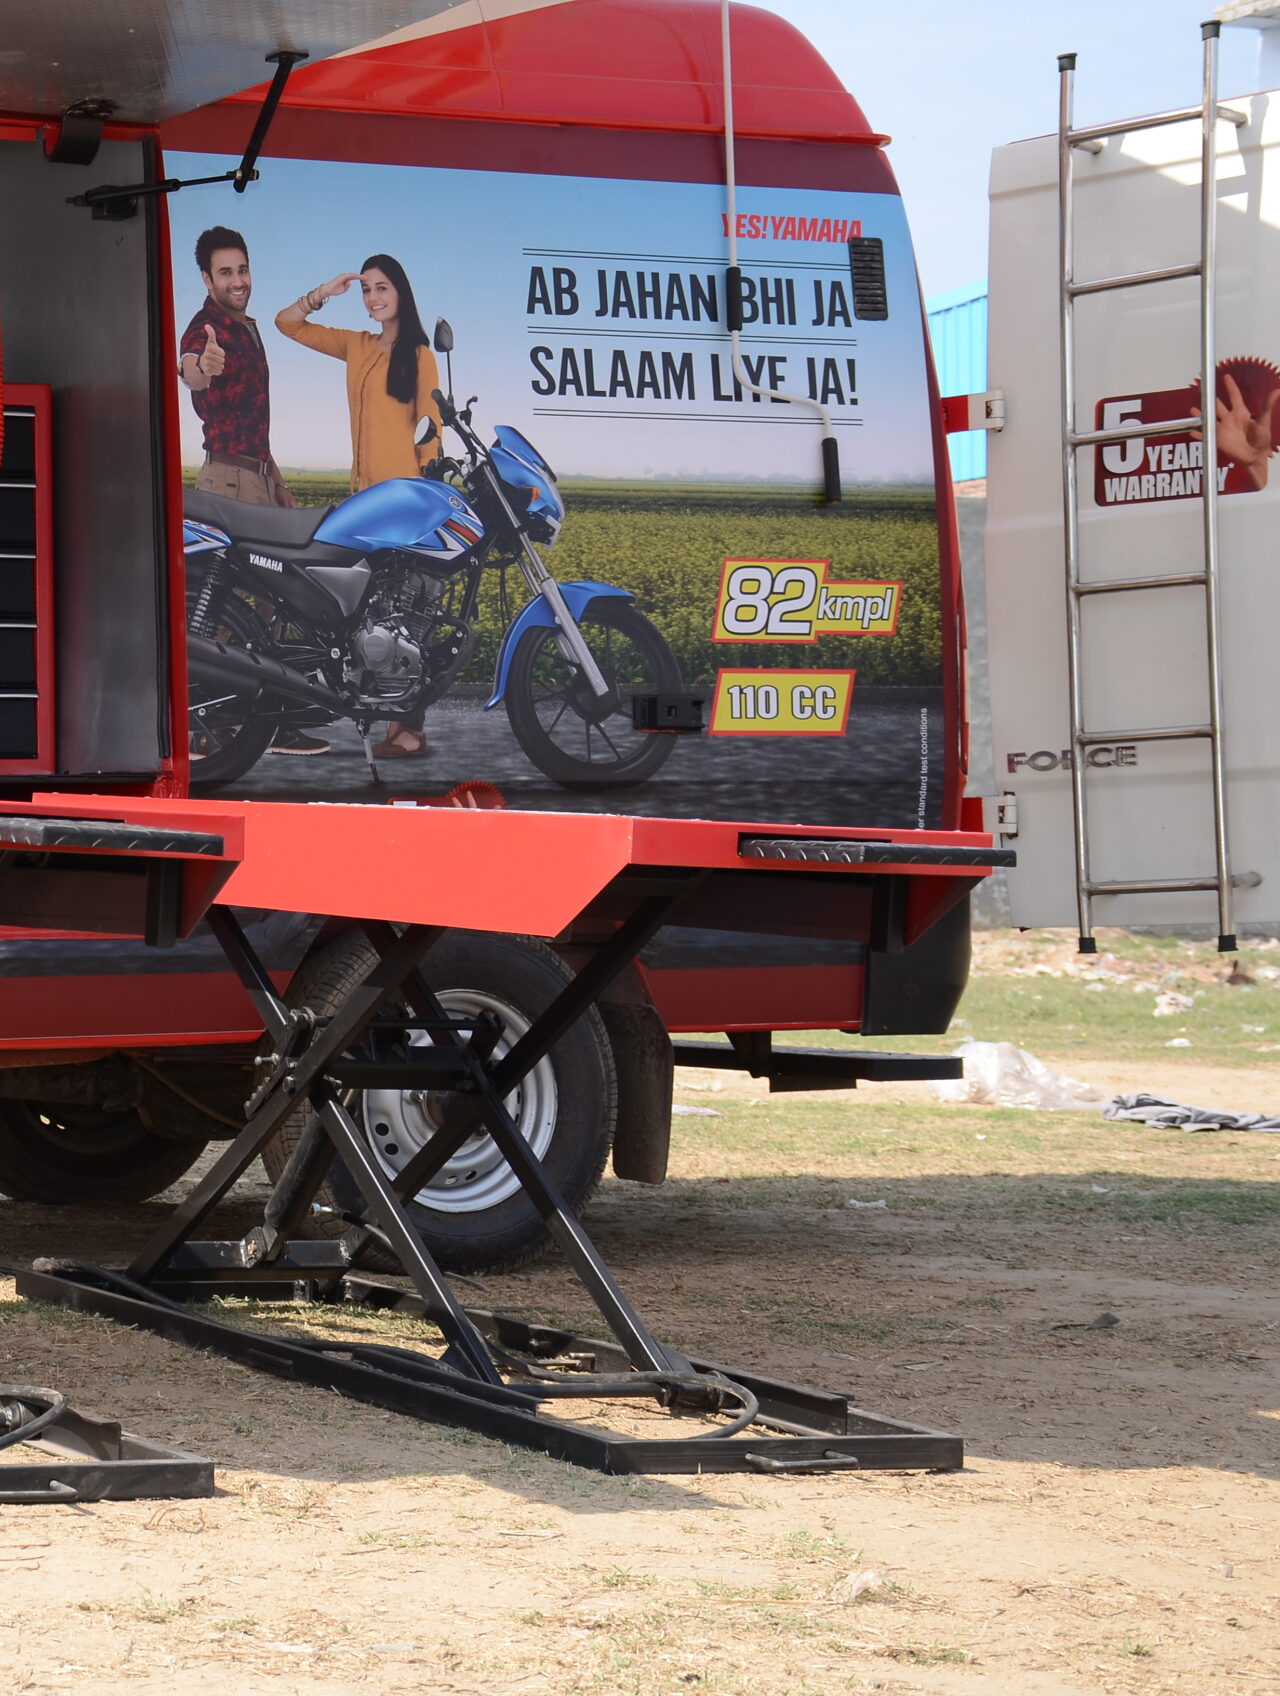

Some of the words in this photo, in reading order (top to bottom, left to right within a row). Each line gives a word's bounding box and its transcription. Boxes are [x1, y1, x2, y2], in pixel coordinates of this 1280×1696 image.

[527, 266, 579, 316] AB
[595, 269, 718, 322] JAHAN
[739, 276, 796, 326] BHI
[812, 279, 852, 327] JA
[529, 346, 696, 401] SALAAM
[807, 356, 858, 406] JA!
[1102, 399, 1145, 474] 5
[249, 553, 283, 573] YAMAHA
[722, 565, 818, 636] 82
[817, 587, 895, 629] kmpl
[727, 685, 779, 720] 110
[791, 685, 836, 720] CC
[920, 707, 928, 755] conditions
[920, 756, 928, 774] test
[918, 776, 928, 817] standard
